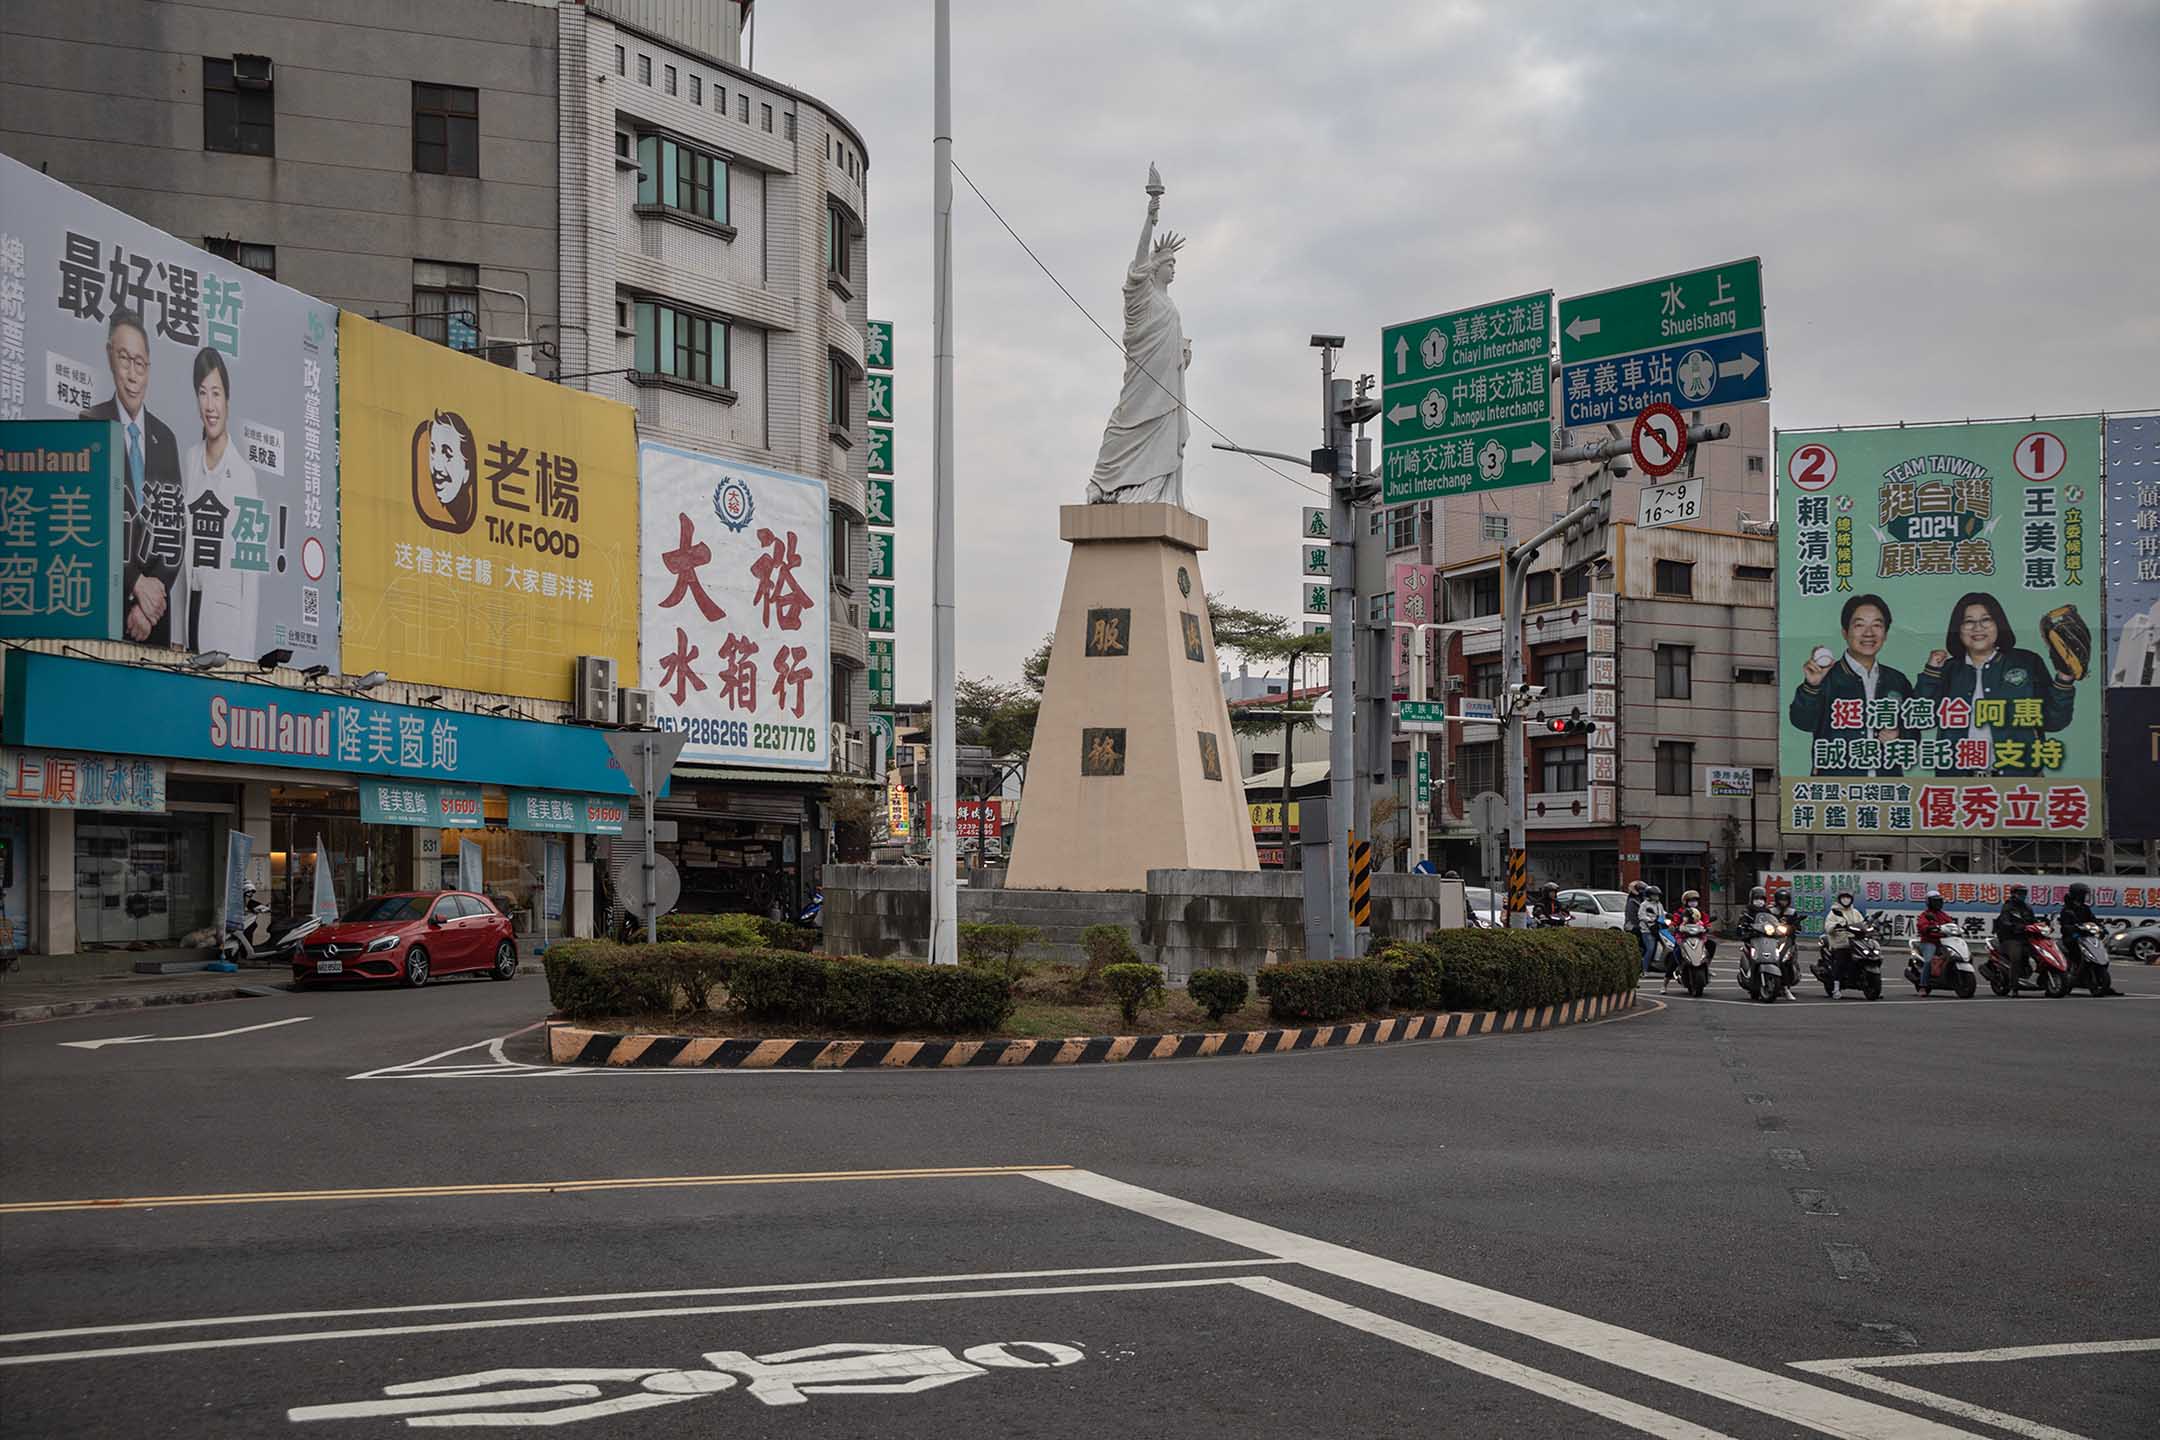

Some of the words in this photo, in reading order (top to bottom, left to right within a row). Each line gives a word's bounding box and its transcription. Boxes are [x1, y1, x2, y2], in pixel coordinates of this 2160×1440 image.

[58, 231, 244, 358] 最好選哲
[1660, 274, 1735, 316] 水上
[1452, 301, 1545, 346] 嘉義交流道
[1660, 309, 1736, 336] Shueishang
[1431, 342, 1437, 357] 1
[1452, 344, 1481, 365] Chiayi
[1483, 335, 1542, 361] Interchange
[1452, 364, 1544, 407] 中埔交流道
[1568, 353, 1673, 400] 嘉義車站
[57, 381, 91, 408] 柯文哲
[1429, 402, 1438, 418] 3
[1570, 397, 1614, 420] Chiayi
[1618, 391, 1671, 412] Station
[1451, 405, 1485, 427] Jhongpu
[1487, 399, 1544, 421] Interchange
[303, 358, 321, 528] 政黨票請投
[1387, 438, 1474, 479] 竹崎交流道
[2028, 438, 2046, 473] 1
[1487, 453, 1497, 469] 3
[1798, 449, 1826, 483] 2
[1885, 457, 1925, 482] TEAM
[1928, 456, 1986, 479] TAIWAN
[484, 440, 578, 523] 老楊
[1387, 481, 1412, 497] Jhuci
[1414, 472, 1472, 491] Interchange
[1655, 485, 1686, 504] 7~9
[0, 485, 103, 547] 隆美
[1645, 500, 1694, 523] 16~18
[1879, 479, 1991, 527] 挺台灣
[517, 524, 579, 559] FOOD
[1908, 516, 1958, 538] 2024
[2024, 487, 2057, 590] 王美惠
[1797, 495, 1830, 596] 賴清德
[1836, 516, 1852, 592] 總統候選人
[1879, 539, 1995, 577] 顧嘉義
[2065, 507, 2082, 586] 立委候選人
[0, 552, 94, 616] 窗飾
[394, 543, 492, 584] 送禮送老楊
[504, 564, 594, 602] 大家喜洋洋
[658, 512, 814, 631] 大裕
[659, 627, 813, 719] 水箱行
[1832, 698, 2044, 729] 挺清德佮阿惠
[211, 695, 330, 756] Sunland
[338, 705, 458, 771] 隆美窗飾
[681, 717, 748, 747] 2286266
[753, 723, 816, 753] 2237778
[1815, 739, 2063, 769] 誠懇拜託擱支持
[6, 754, 153, 806] 上順加水站
[378, 787, 428, 814] 隆美窗飾
[527, 797, 575, 821] 隆美窗飾
[1793, 806, 1911, 829] 評鑑獲選
[1919, 785, 2089, 830] 優秀立委
[423, 839, 437, 852] 831
[1866, 881, 1928, 902] 商業區
[2030, 885, 2115, 907] 財庫位
